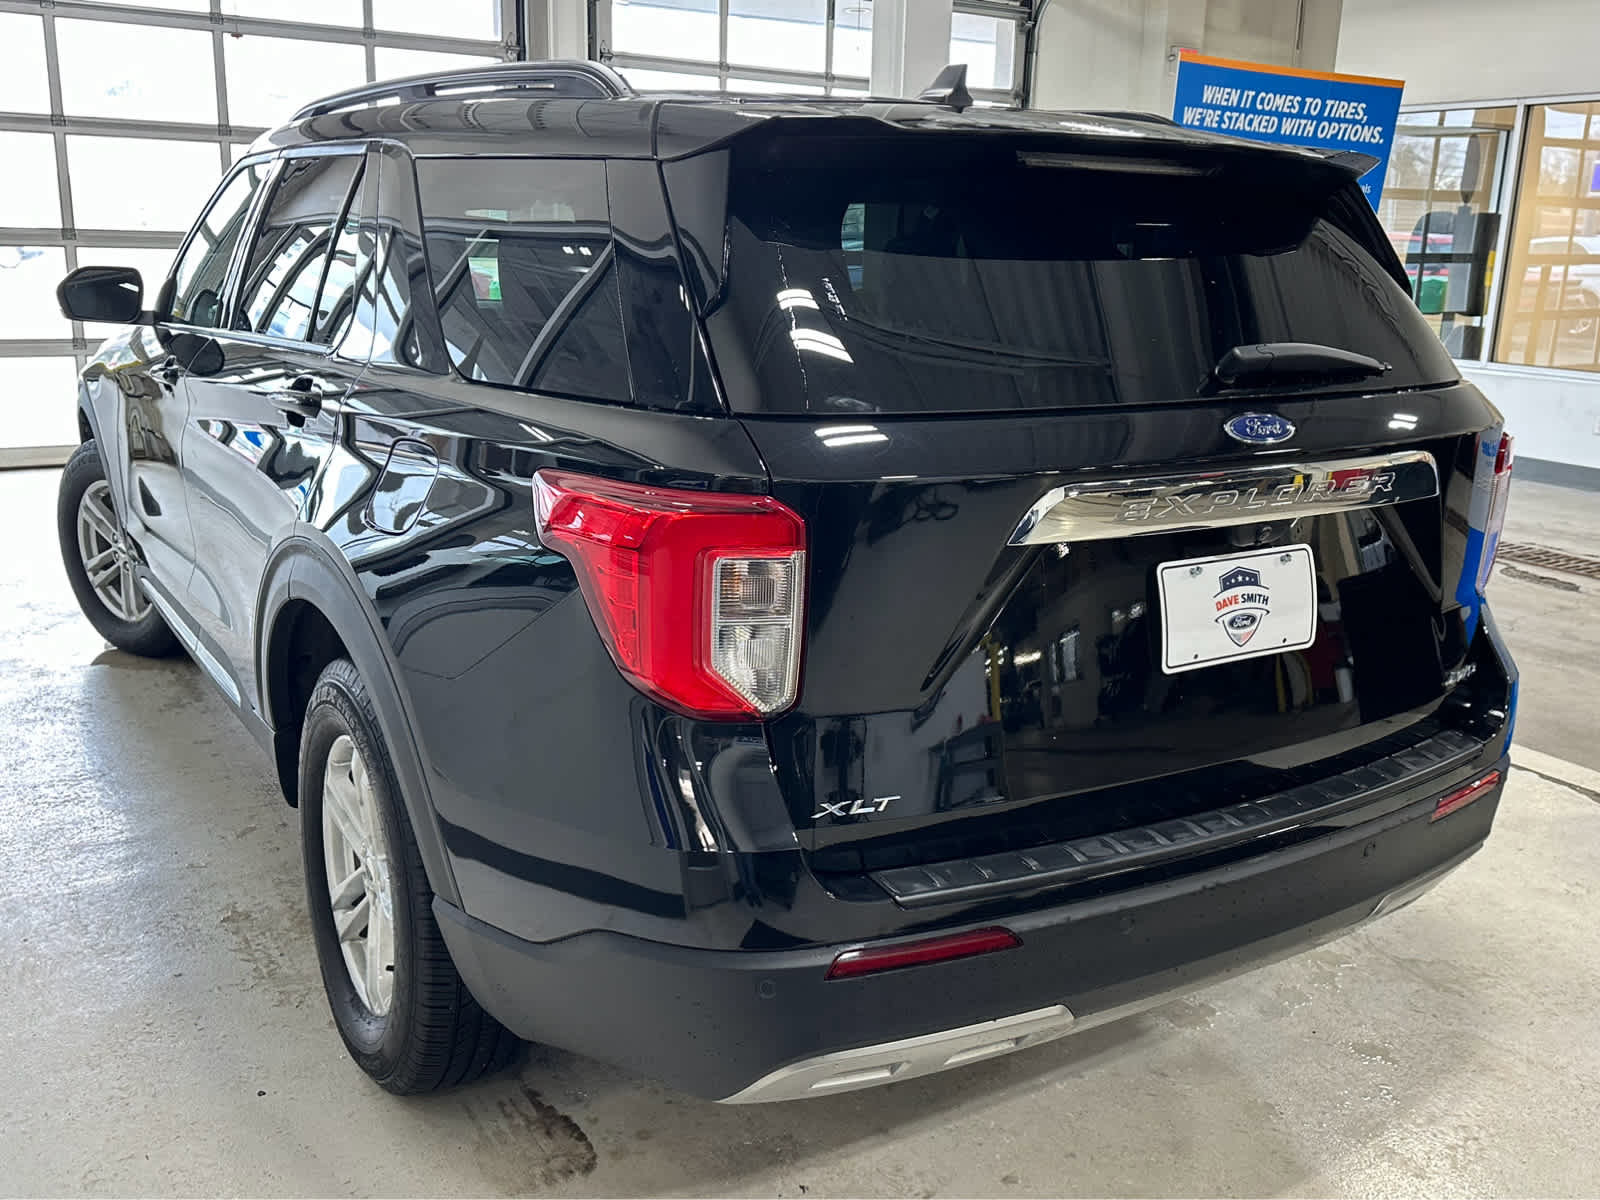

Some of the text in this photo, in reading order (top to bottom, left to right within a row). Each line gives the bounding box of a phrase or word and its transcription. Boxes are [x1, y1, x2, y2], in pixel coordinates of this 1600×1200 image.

[1203, 85, 1369, 124] WHEN IT COMES TO TIRES,
[1183, 106, 1385, 144] WE'RE STACKED WITH OPTIONS.
[1245, 418, 1282, 436] Ford
[1113, 471, 1397, 522] EXPLORER
[1215, 593, 1269, 612] DAVE SMITH
[810, 795, 902, 820] XLT
